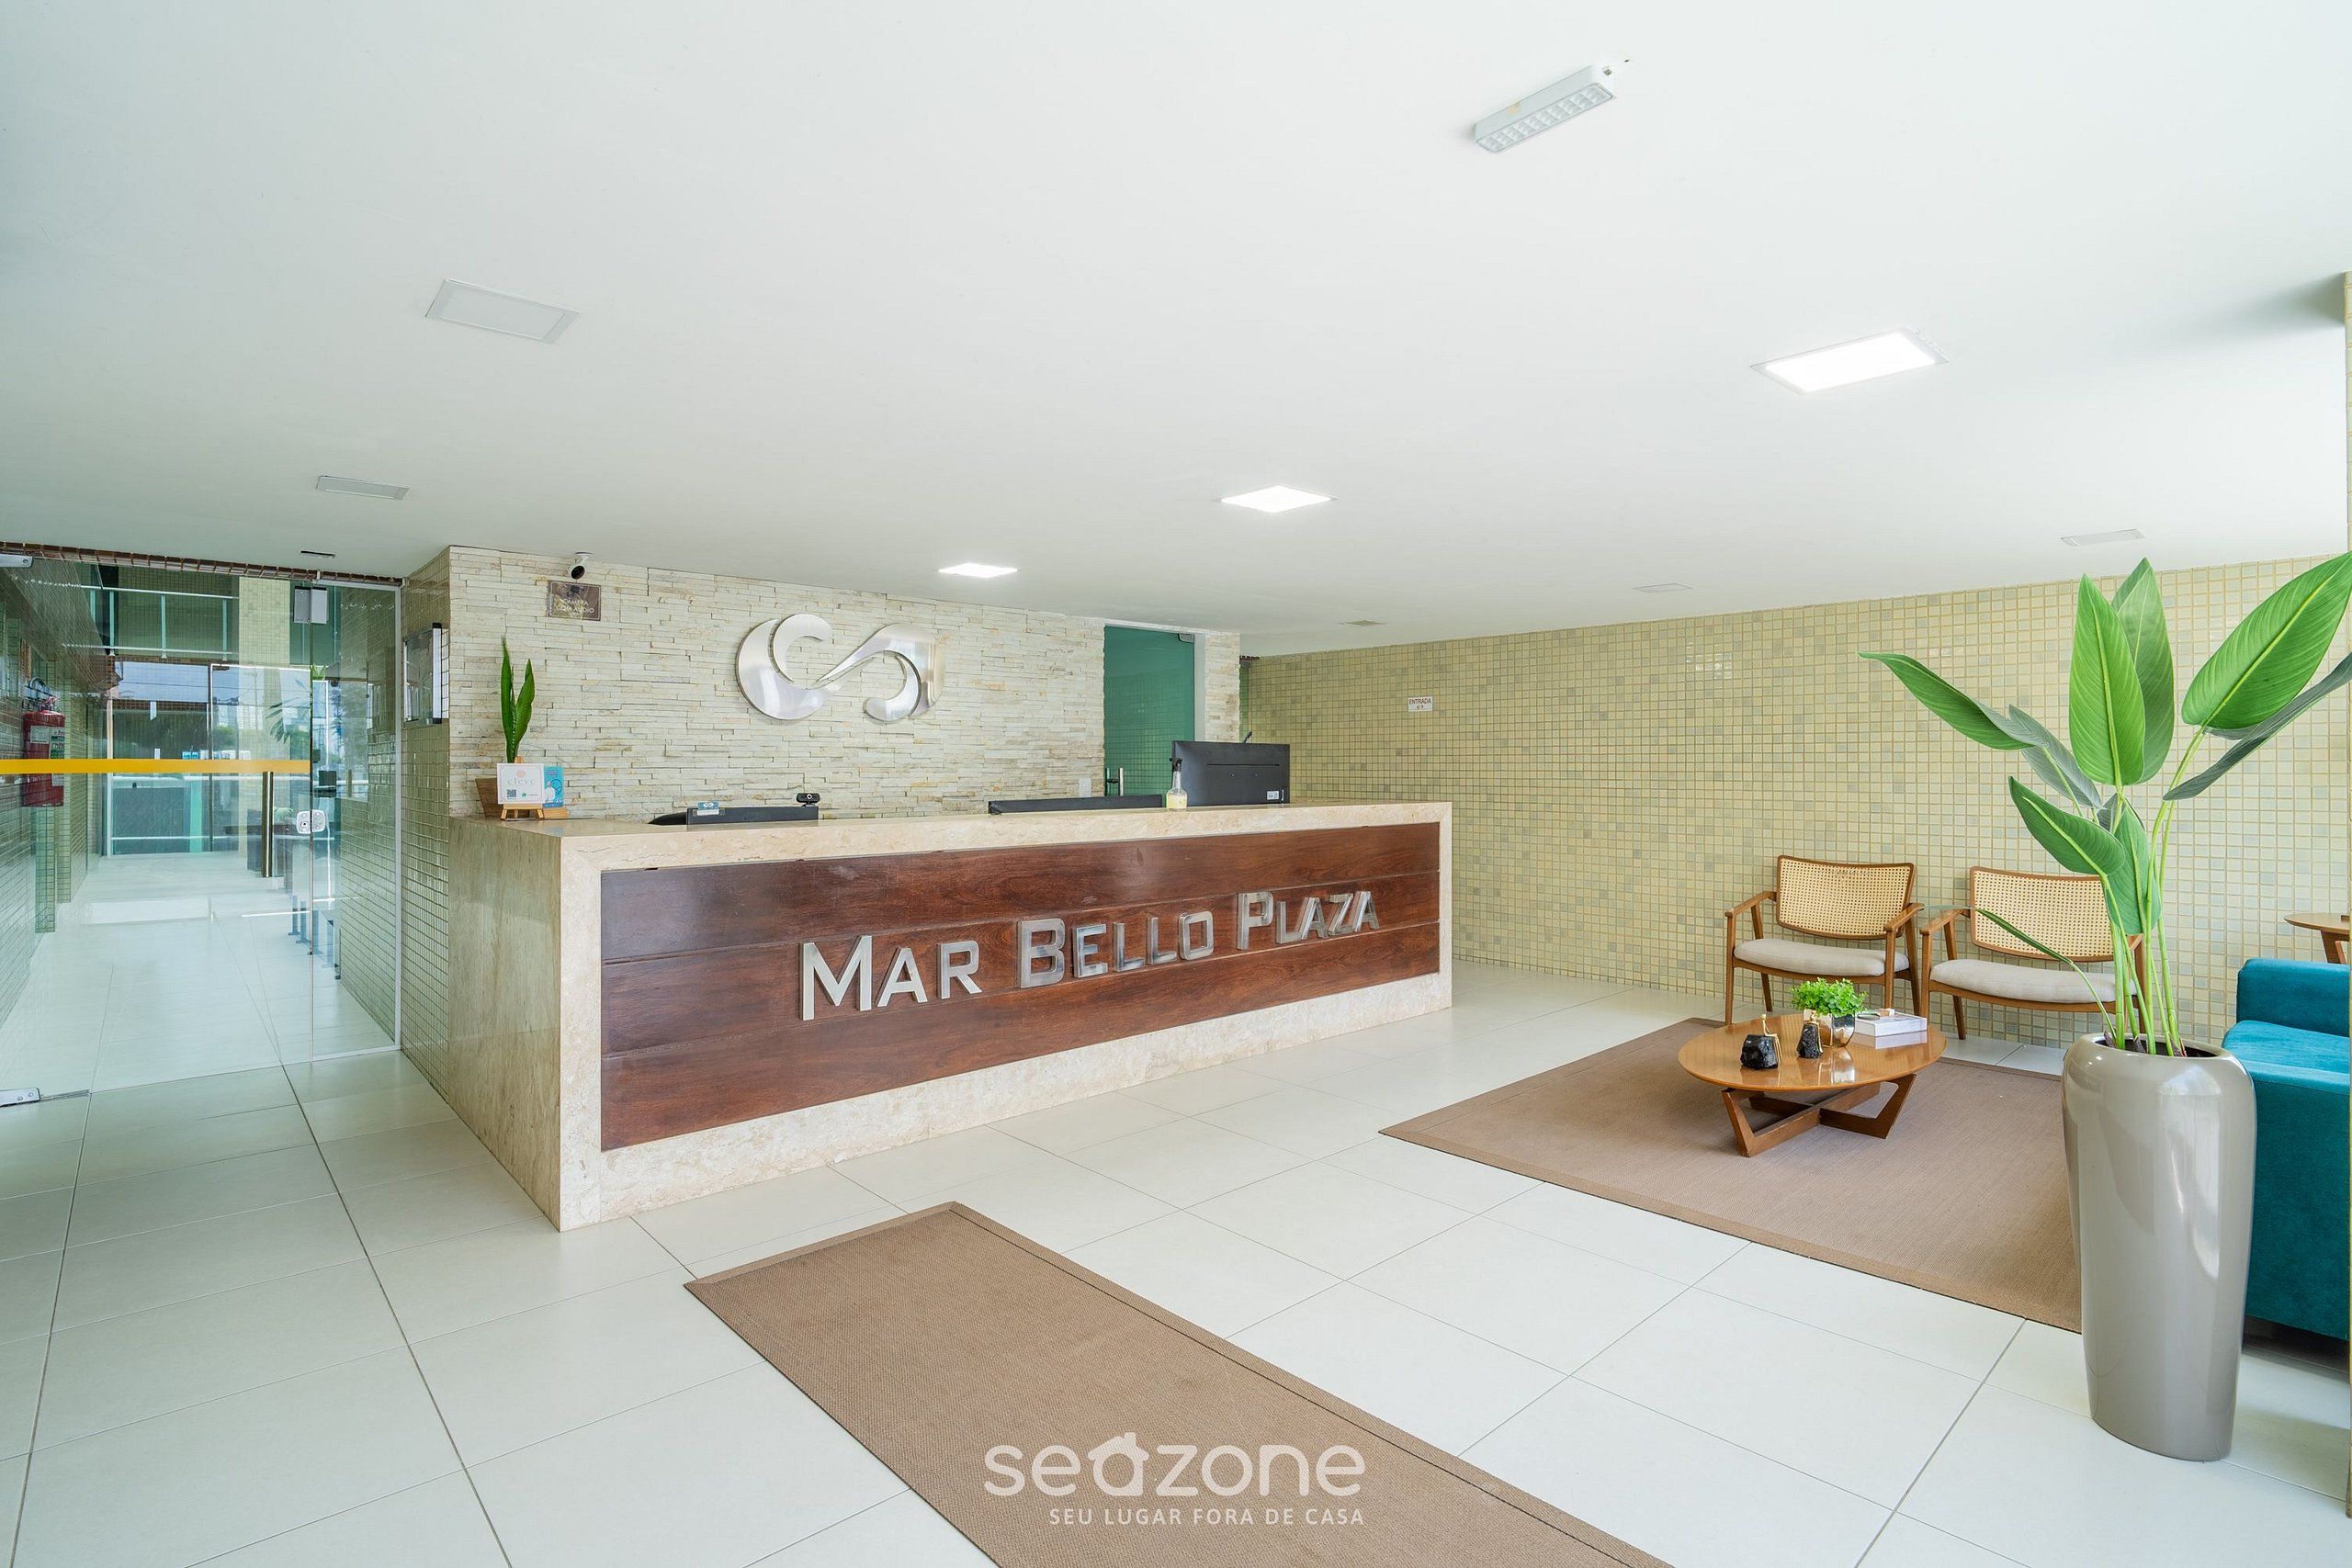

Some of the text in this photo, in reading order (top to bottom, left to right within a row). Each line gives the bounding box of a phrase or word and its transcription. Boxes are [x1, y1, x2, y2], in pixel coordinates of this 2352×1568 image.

[798, 890, 1380, 1021] MAR BELLO PLAZA
